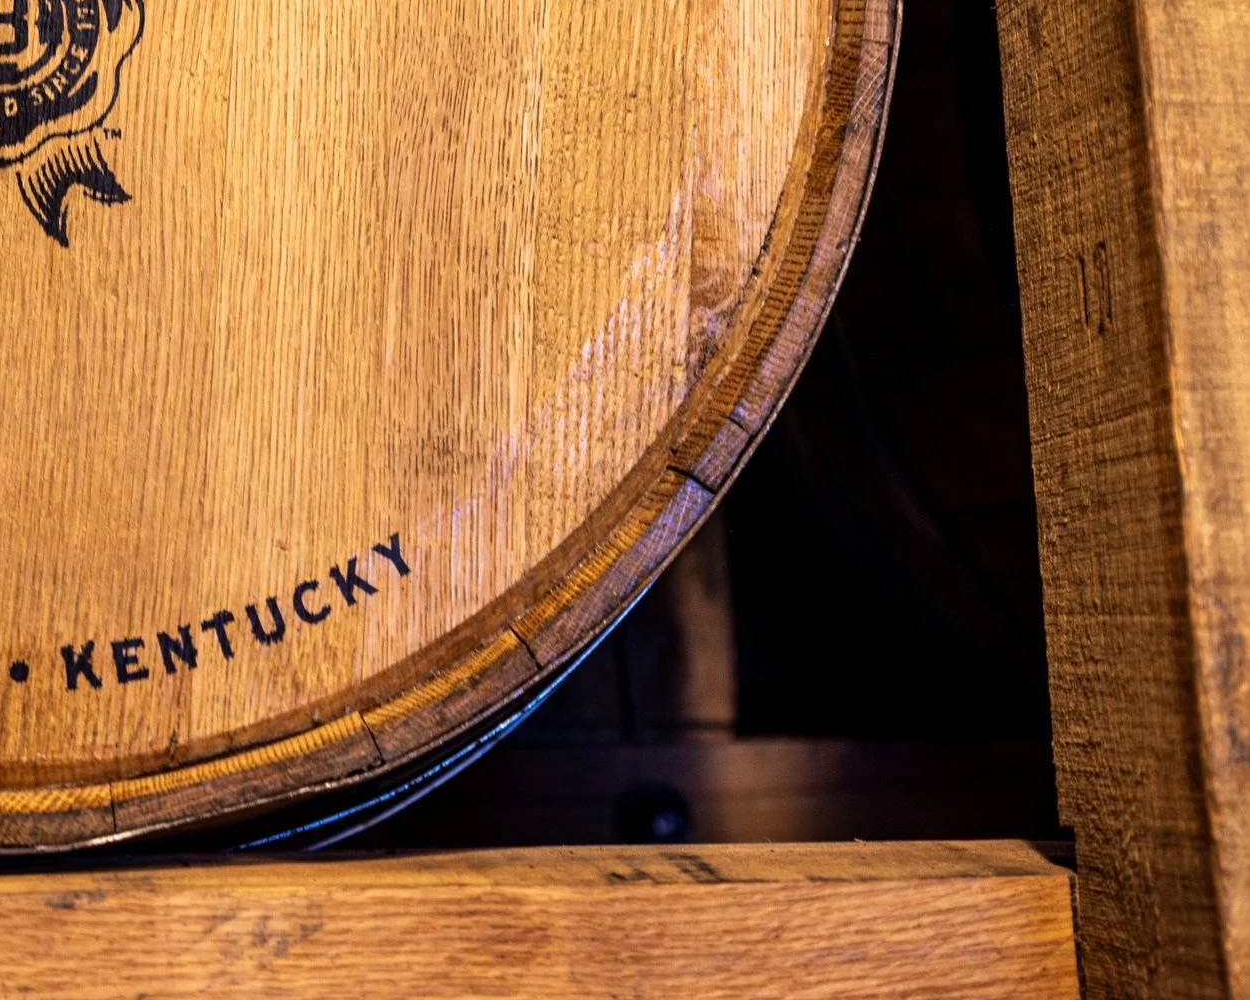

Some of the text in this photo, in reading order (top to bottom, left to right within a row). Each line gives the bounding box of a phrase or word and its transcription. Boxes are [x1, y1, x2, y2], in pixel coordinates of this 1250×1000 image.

[31, 43, 88, 106] SINCE
[103, 128, 123, 140] TM
[59, 532, 412, 693] KENTUCKY
